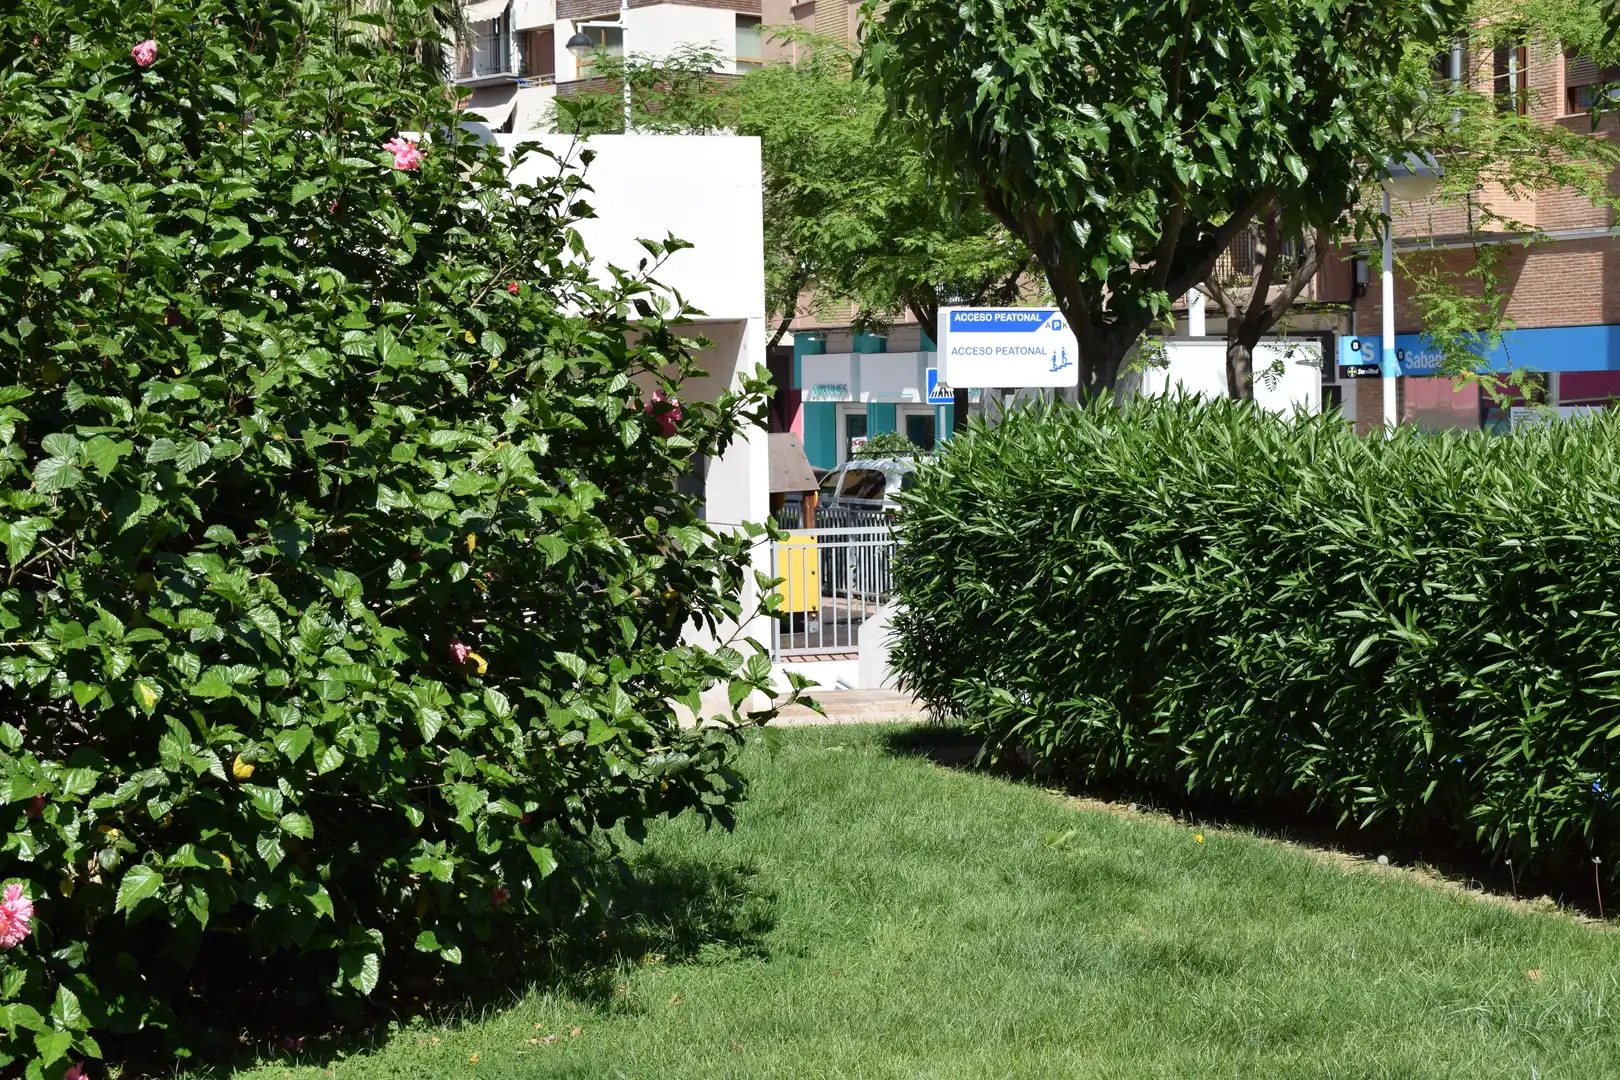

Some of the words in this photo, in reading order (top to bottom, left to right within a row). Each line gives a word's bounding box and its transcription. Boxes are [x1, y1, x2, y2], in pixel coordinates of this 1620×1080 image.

[954, 313, 992, 322] ACCESO
[994, 313, 1042, 322] PEATONAL
[951, 346, 993, 356] ACCESO
[995, 346, 1047, 356] PEATONAL
